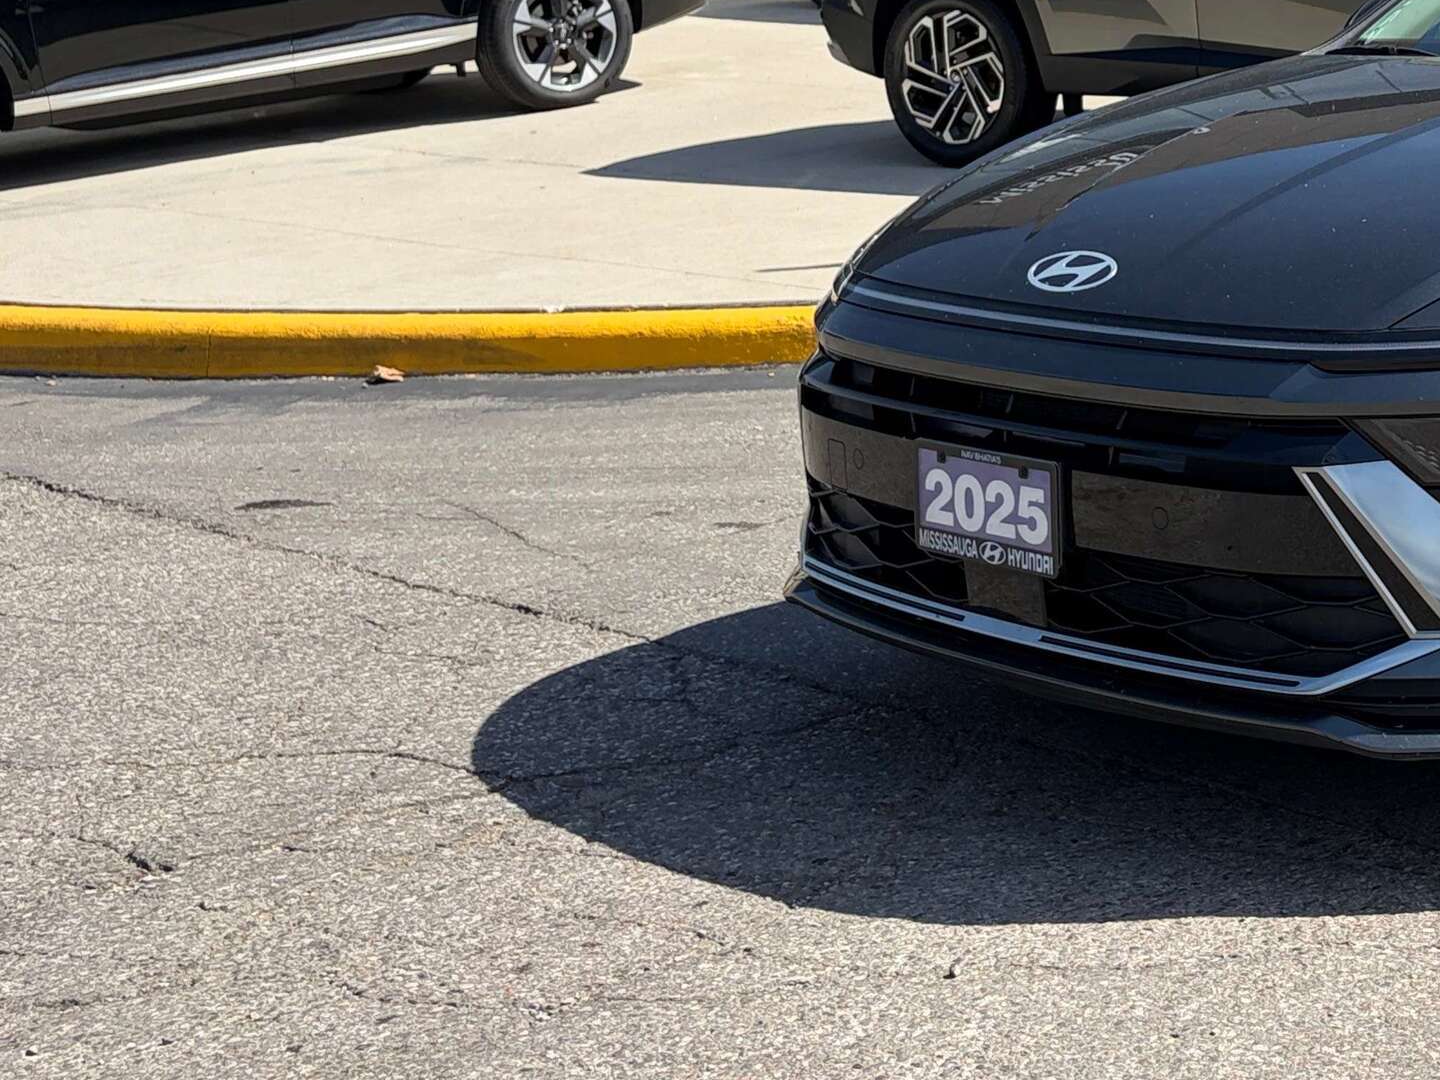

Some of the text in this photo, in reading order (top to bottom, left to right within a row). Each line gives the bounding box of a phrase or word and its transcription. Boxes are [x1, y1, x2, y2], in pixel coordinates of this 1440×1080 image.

[925, 468, 1049, 546] 2025
[919, 527, 1053, 576] MISSISSAUGA HYUNDAI
